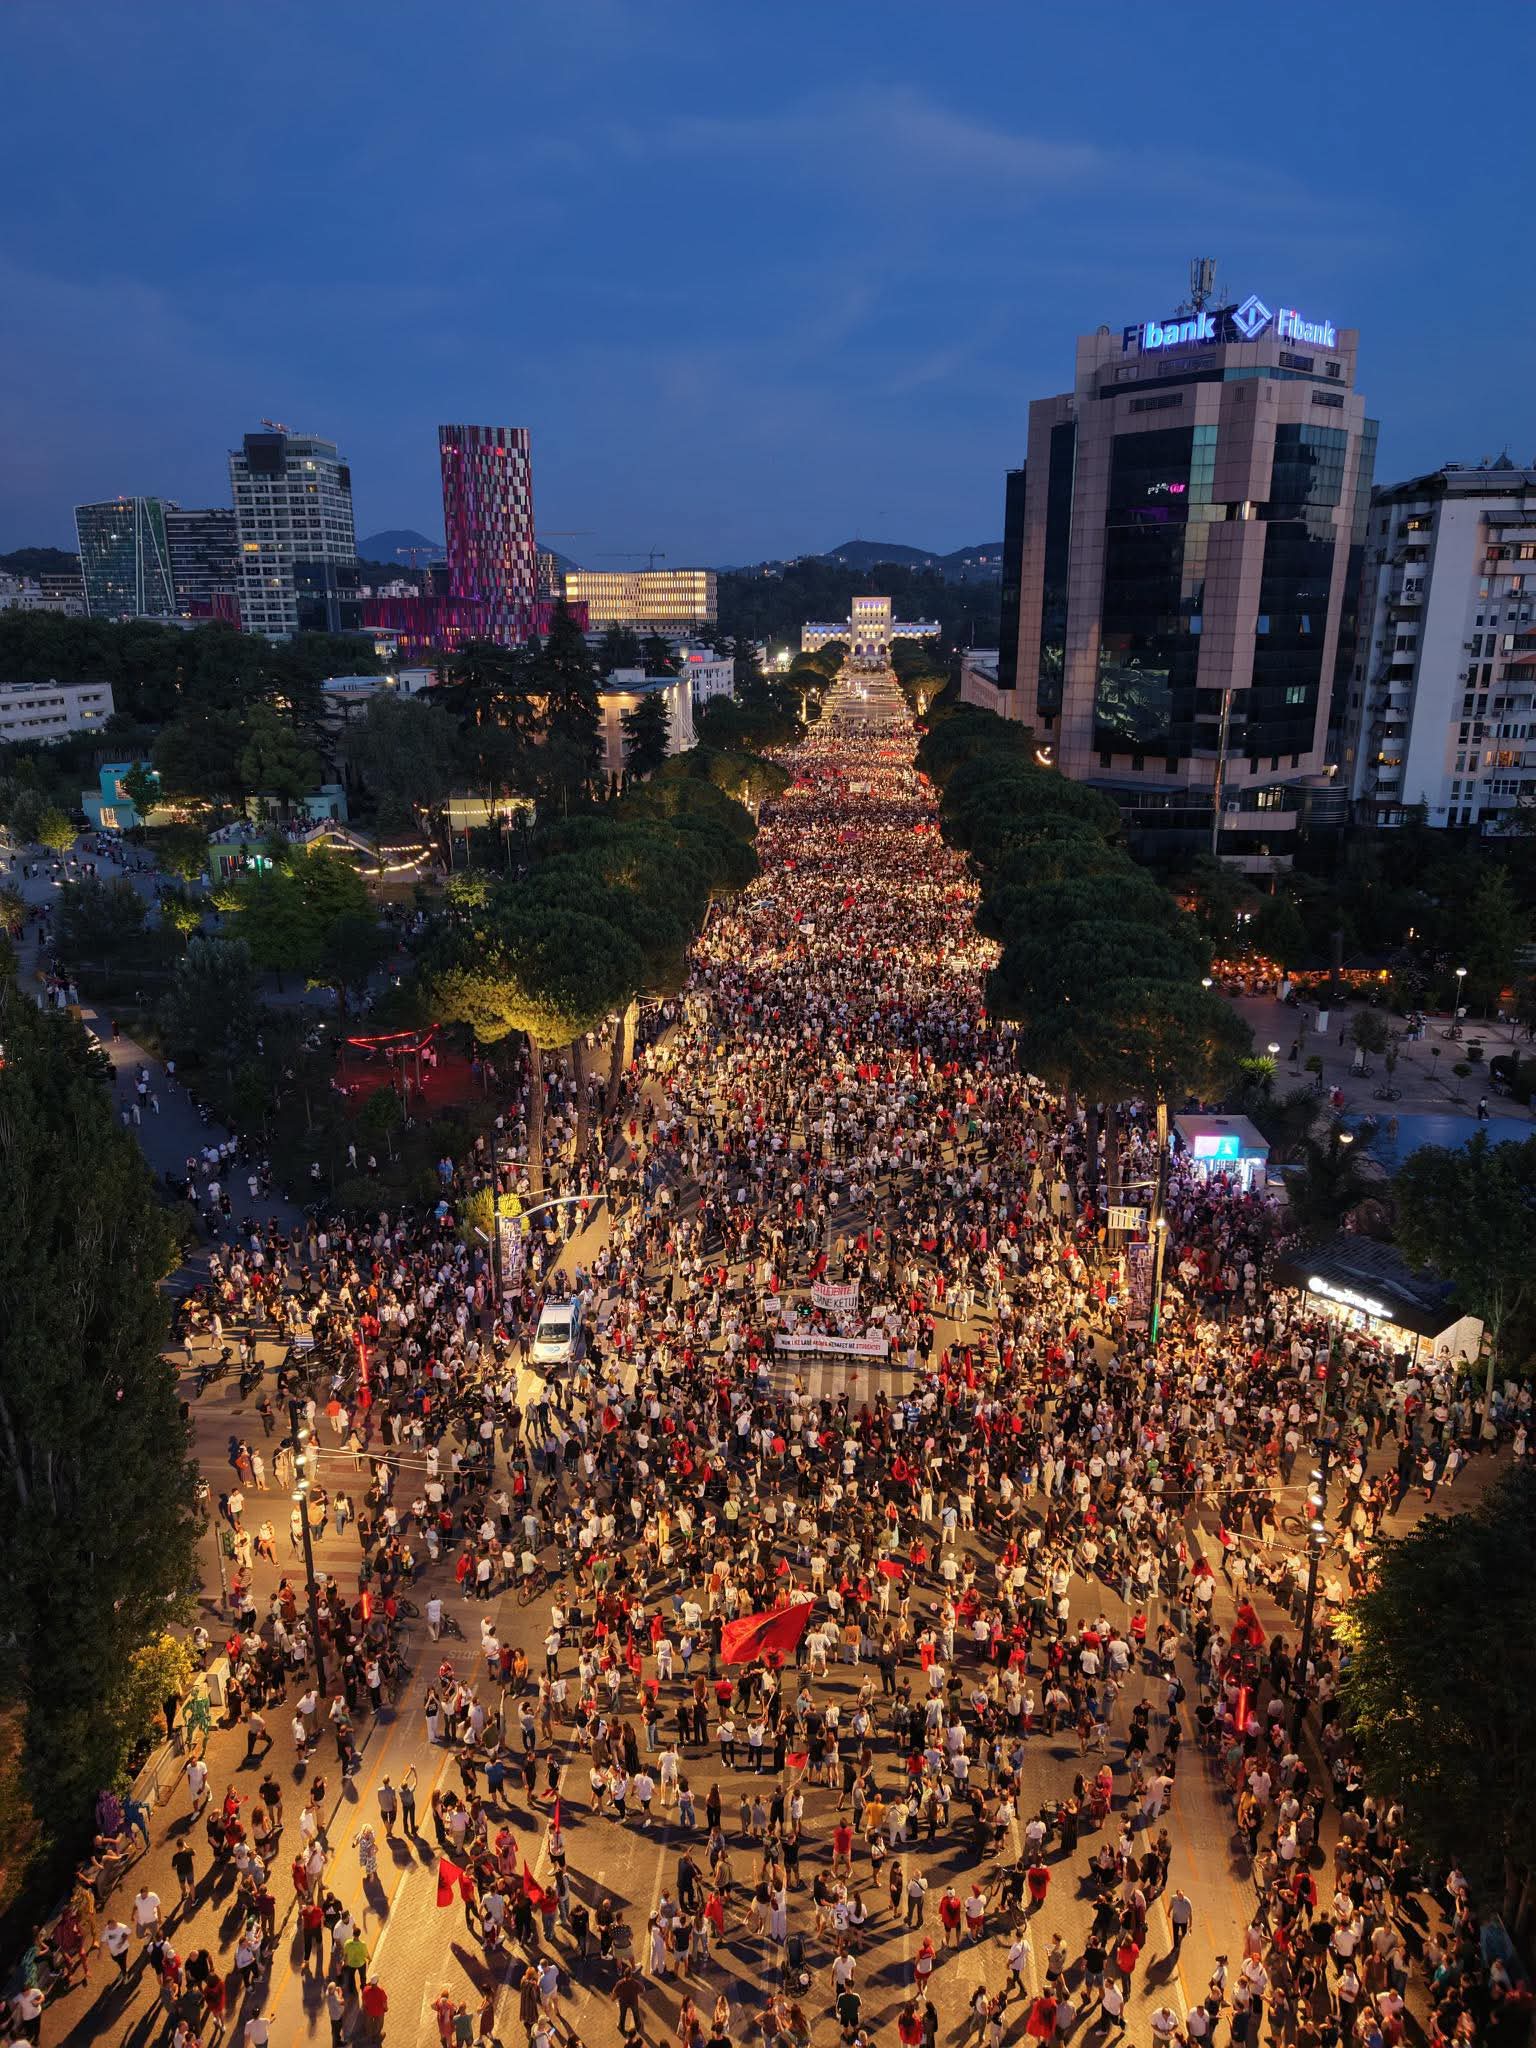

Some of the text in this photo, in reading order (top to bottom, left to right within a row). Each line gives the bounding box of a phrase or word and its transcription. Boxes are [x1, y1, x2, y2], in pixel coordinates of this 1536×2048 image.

[1122, 312, 1216, 351] Fibank
[1278, 308, 1336, 347] Fibank
[447, 1649, 480, 1659] STOP
[836, 1913, 843, 1924] 5
